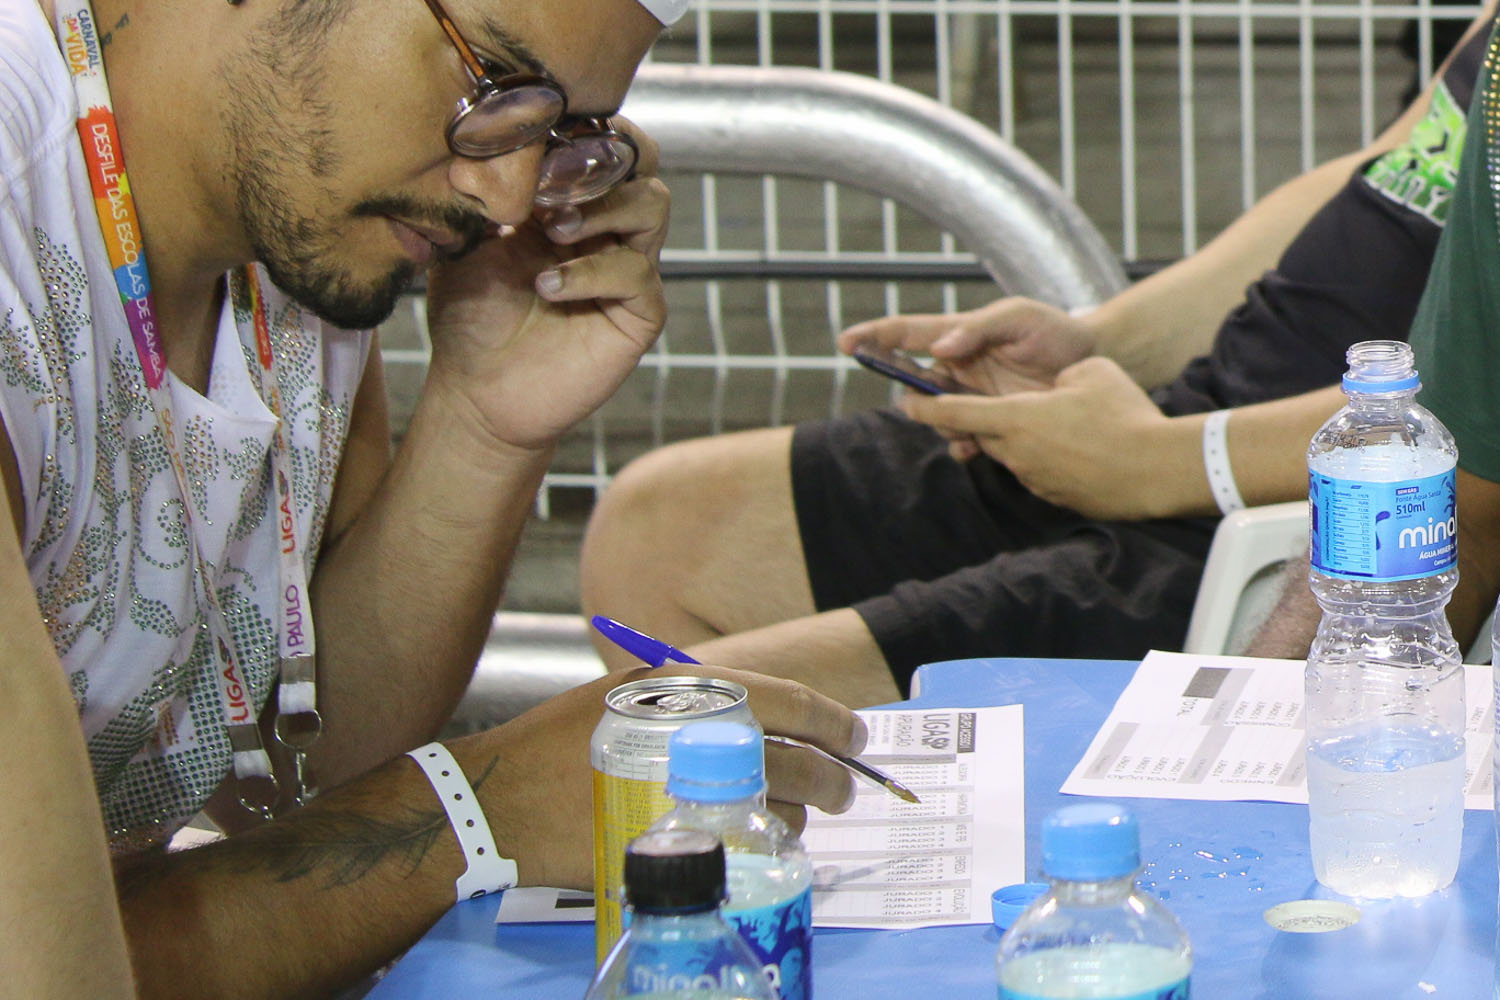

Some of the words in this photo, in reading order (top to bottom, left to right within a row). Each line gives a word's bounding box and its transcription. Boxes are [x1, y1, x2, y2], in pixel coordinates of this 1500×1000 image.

[65, 33, 88, 77] VIDA
[76, 8, 100, 69] CARNAVAL
[91, 122, 119, 185] DESFILE
[107, 184, 128, 221] DAS
[115, 221, 146, 300] ESCOLAS
[136, 297, 151, 320] DE
[141, 320, 162, 380] SAMBA
[1396, 500, 1426, 515] 510ml
[284, 584, 305, 649] PAULO
